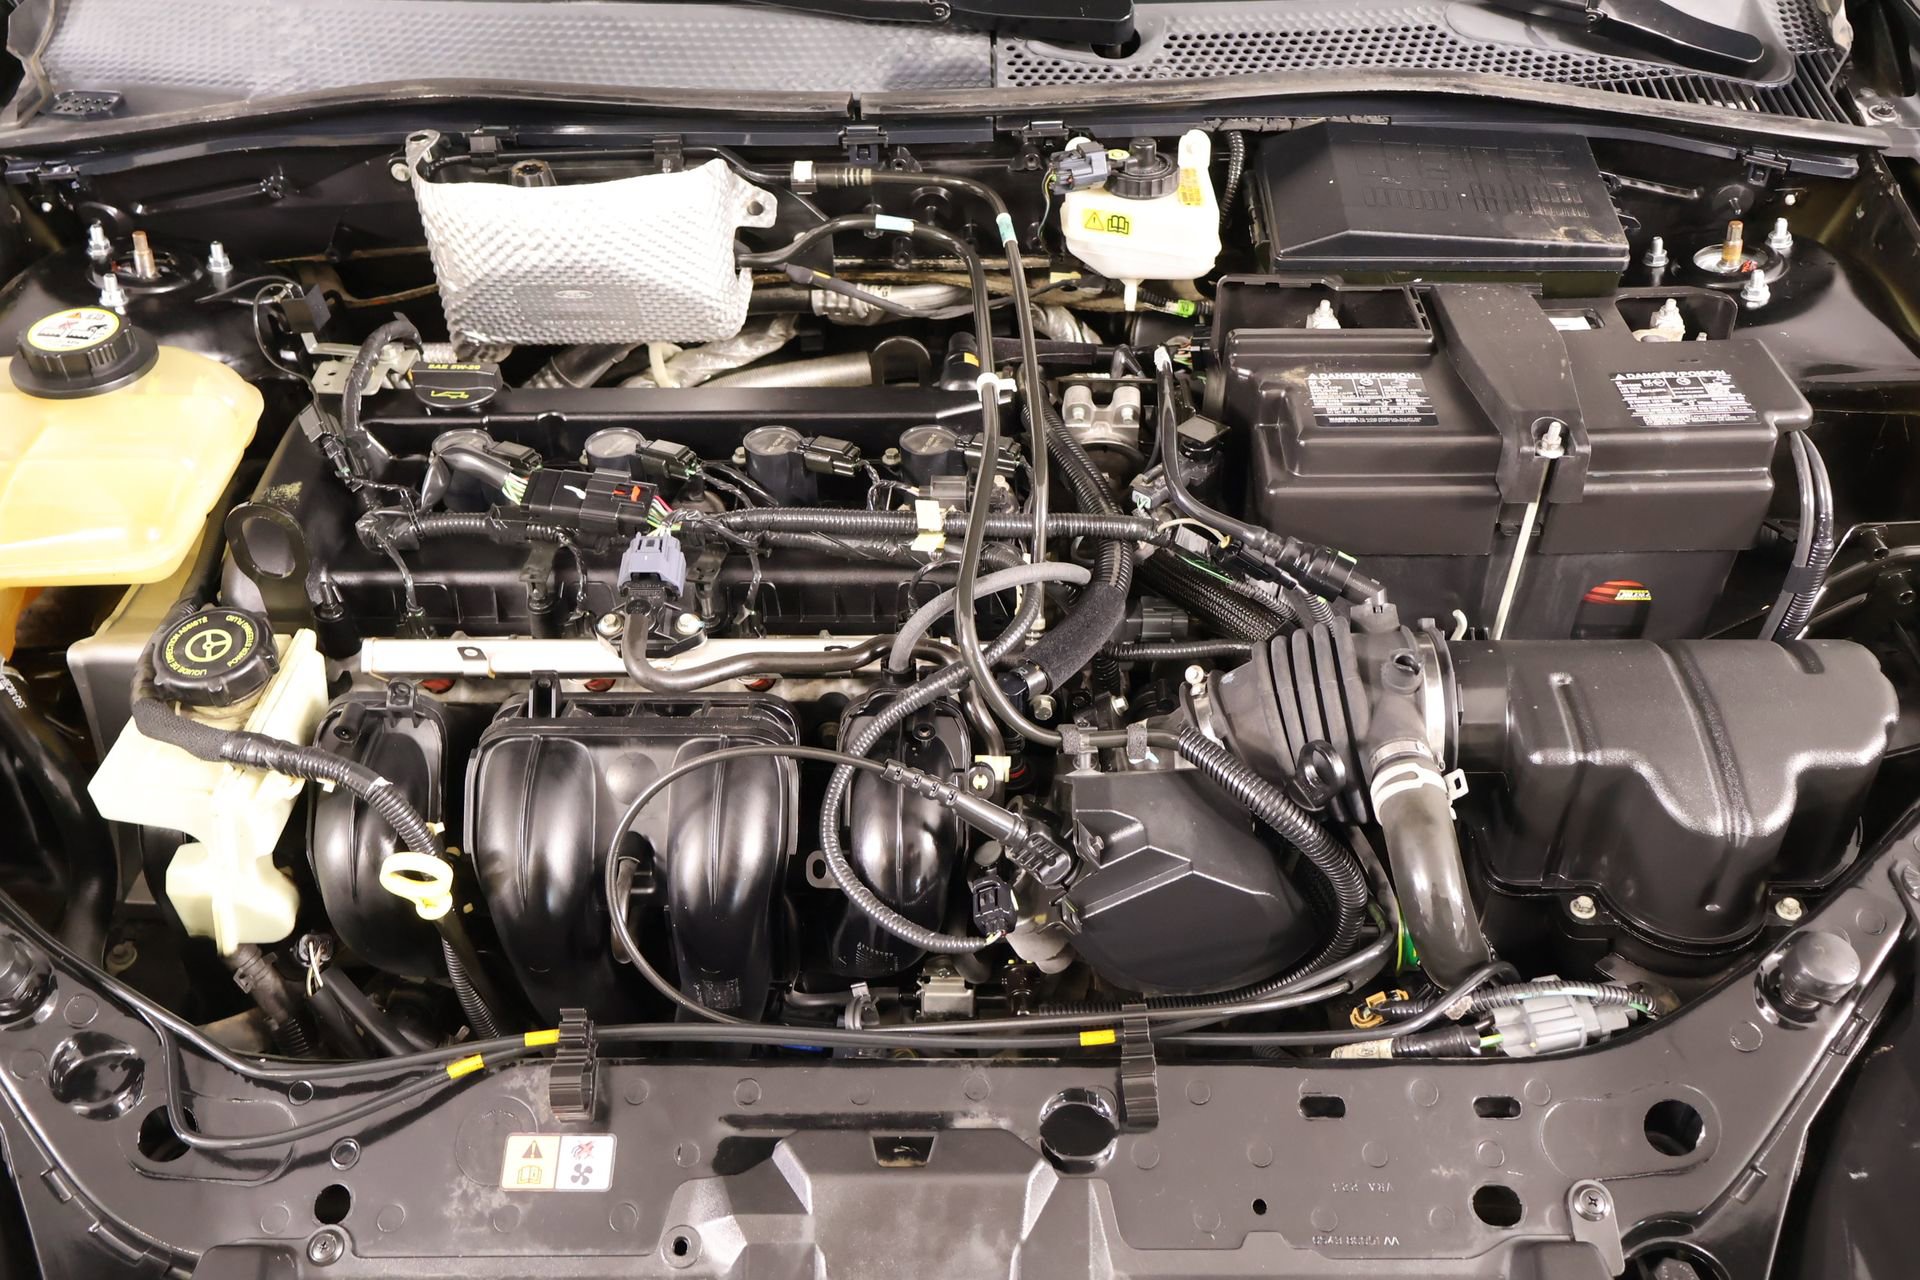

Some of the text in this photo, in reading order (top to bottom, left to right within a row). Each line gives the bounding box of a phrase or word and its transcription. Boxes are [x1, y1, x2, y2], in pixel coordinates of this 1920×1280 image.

[1626, 370, 1727, 379] DANGER/POISON
[226, 615, 254, 667] POWER STEERING FLUID
[165, 634, 180, 662] DIRECTION
[170, 661, 179, 670] DE
[178, 666, 208, 676] LIQUIDE
